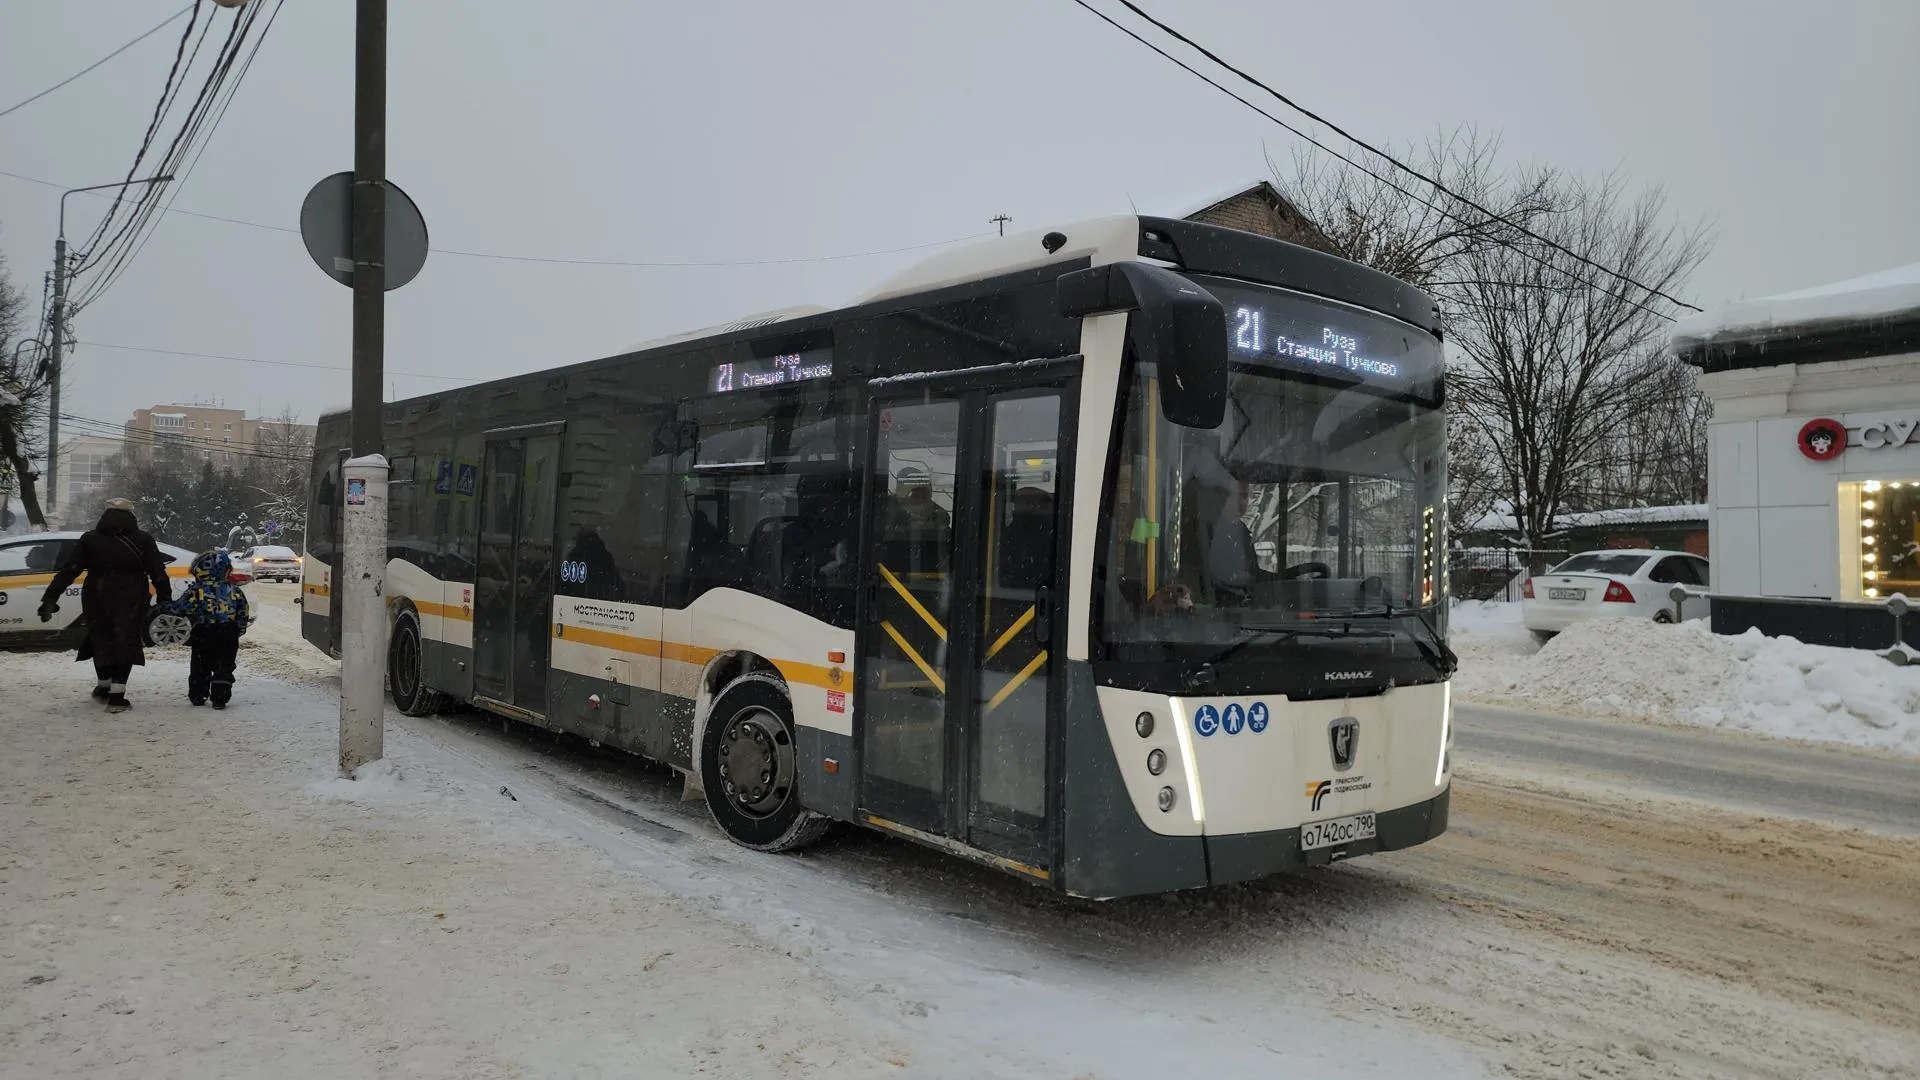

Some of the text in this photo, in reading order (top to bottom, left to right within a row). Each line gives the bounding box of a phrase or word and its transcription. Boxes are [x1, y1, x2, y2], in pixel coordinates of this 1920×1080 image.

[1237, 308, 1260, 350] 21
[1323, 327, 1356, 350] Руза
[775, 354, 801, 368] Руза
[1277, 336, 1397, 376] Станция Тучково
[718, 363, 733, 392] 21
[742, 371, 784, 387] Станция
[574, 604, 635, 622] МОСТРАНСАВТО
[1324, 670, 1374, 680] KAMAZ
[1355, 815, 1373, 831] 790
